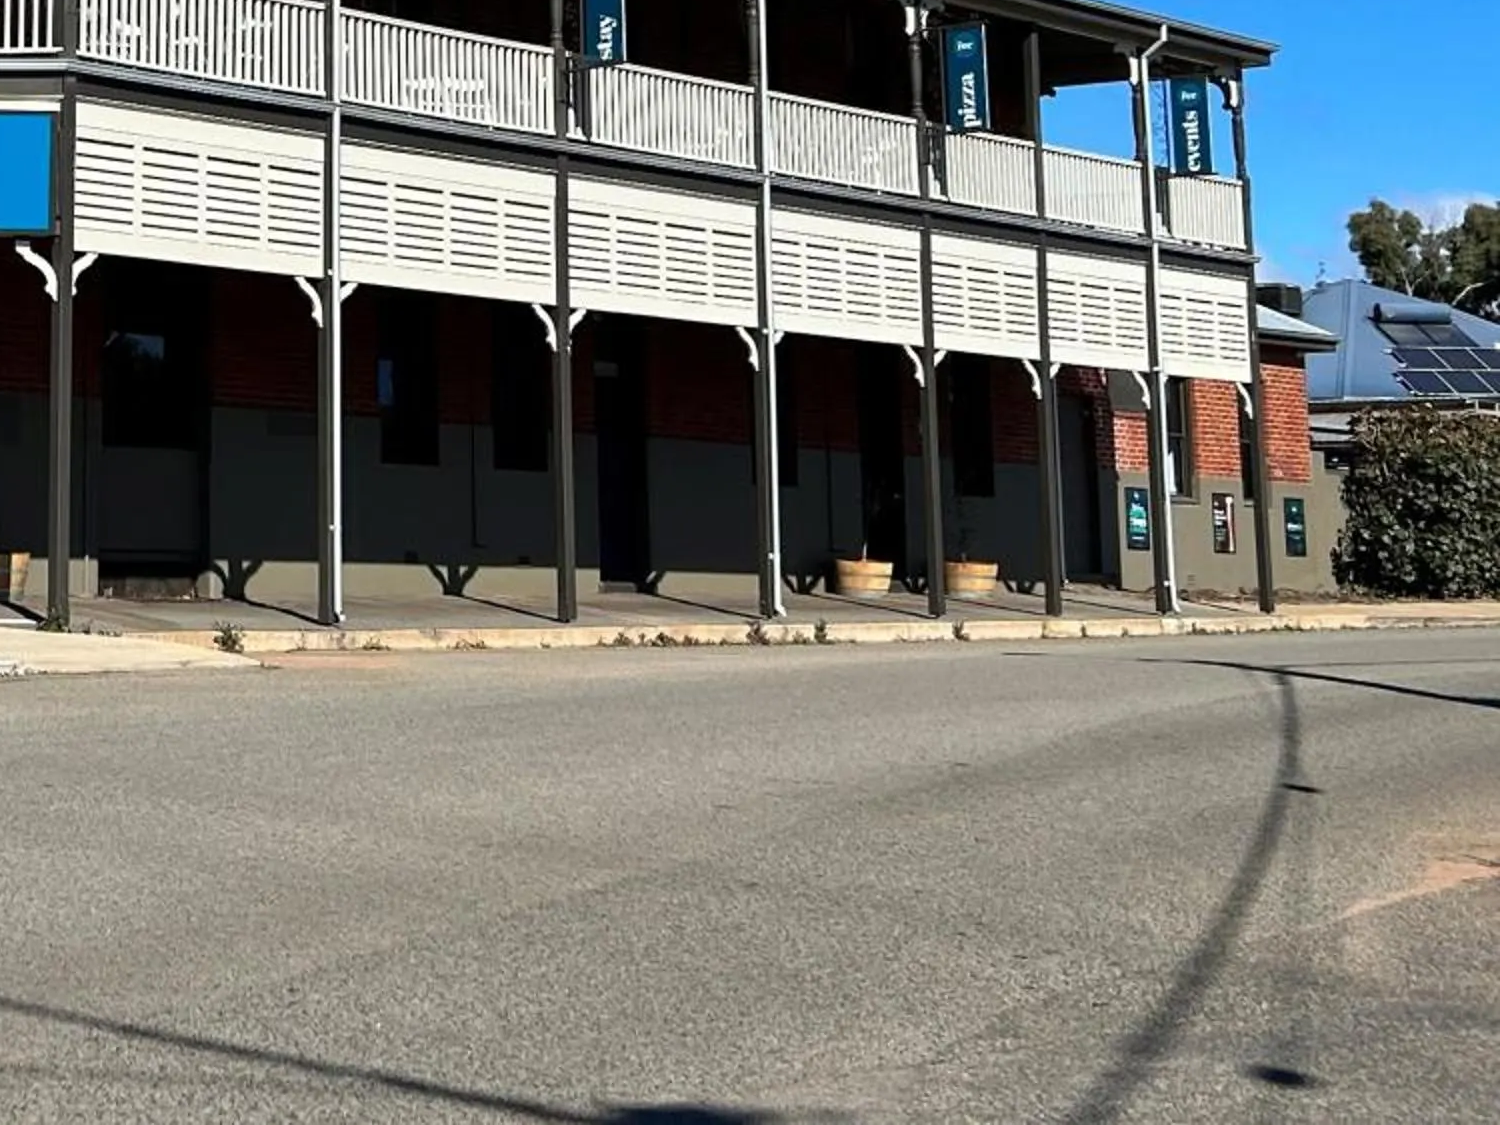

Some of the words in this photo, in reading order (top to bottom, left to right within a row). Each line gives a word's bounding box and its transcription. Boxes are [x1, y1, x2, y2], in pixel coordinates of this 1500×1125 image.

[596, 15, 617, 61] stay
[957, 71, 982, 127] pizza
[1182, 110, 1201, 172] events
